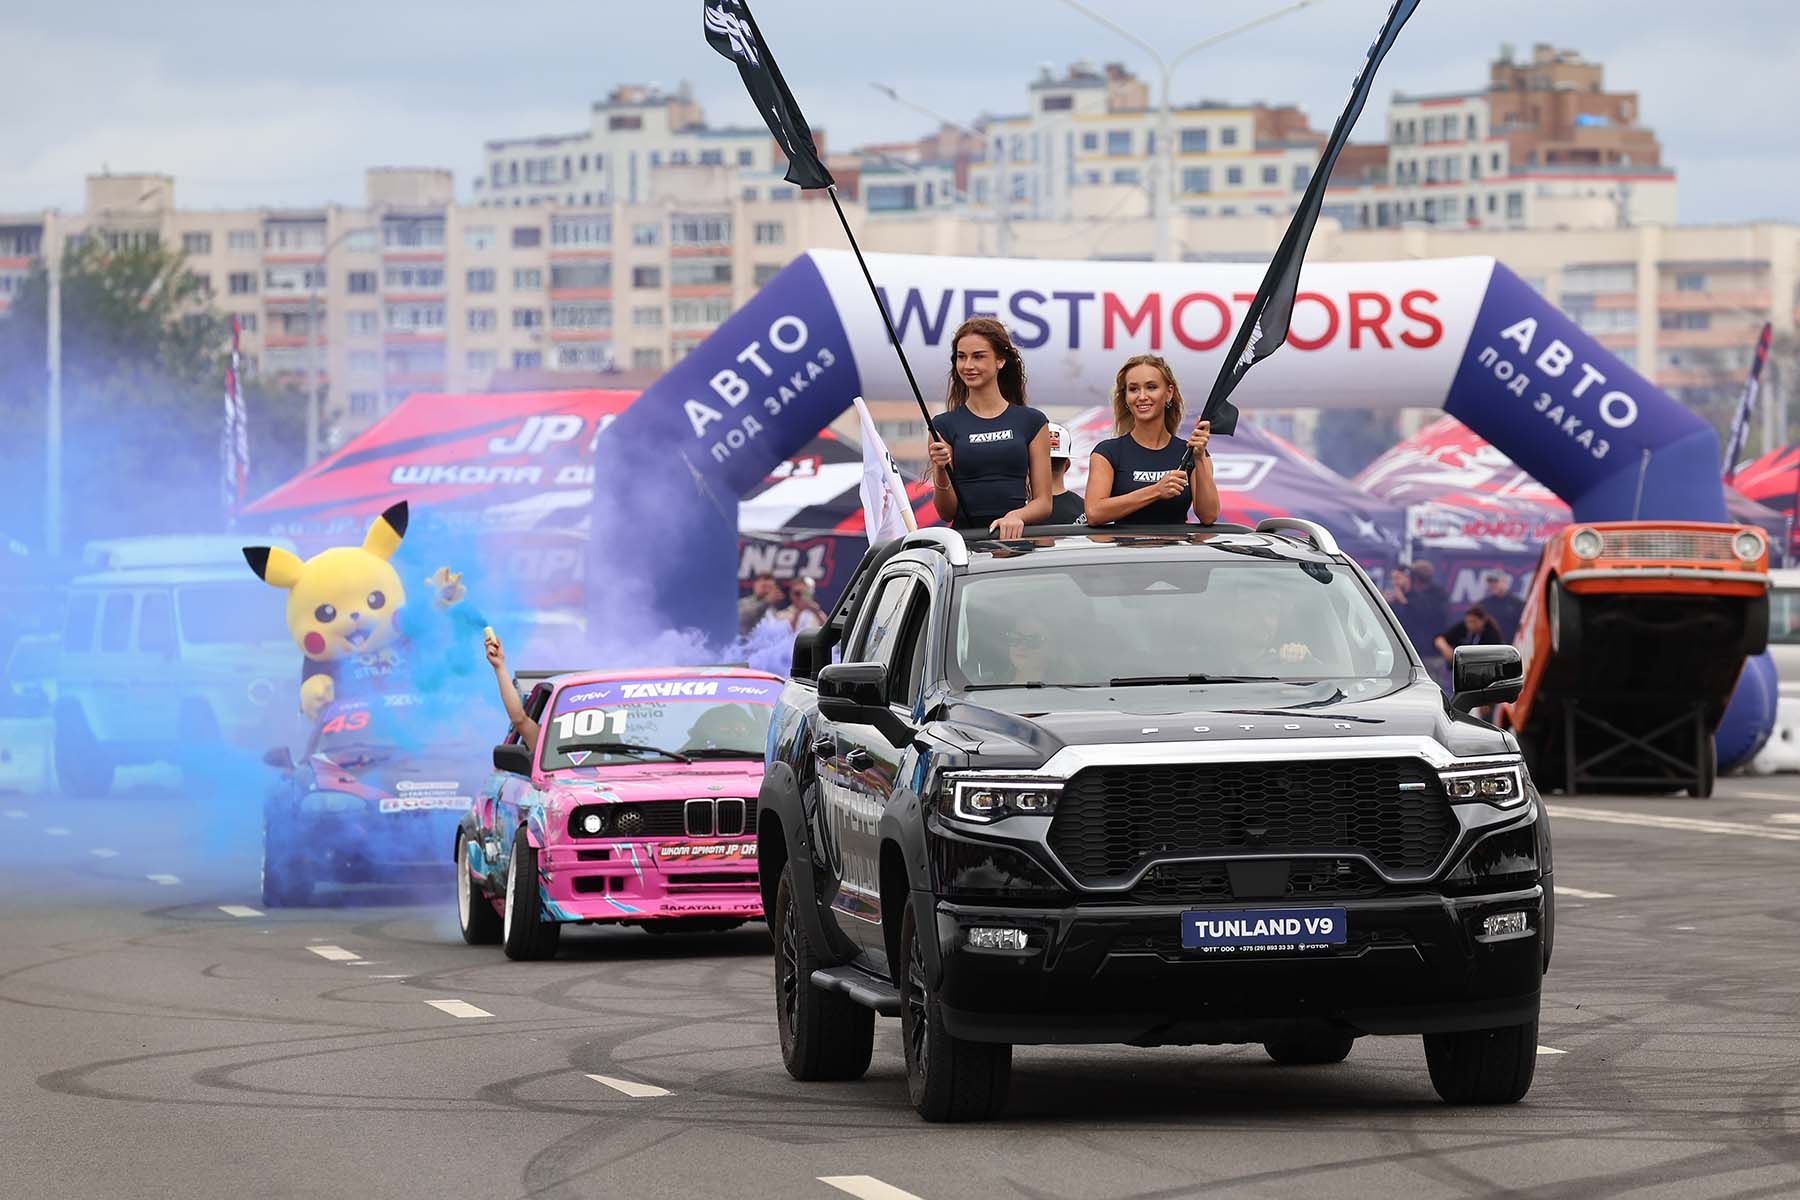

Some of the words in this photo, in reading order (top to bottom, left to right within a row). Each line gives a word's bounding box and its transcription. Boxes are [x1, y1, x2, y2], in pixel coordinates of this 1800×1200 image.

[682, 315, 808, 438] АВТО
[1500, 316, 1638, 429] АВТО
[711, 416, 762, 463] ПОД
[764, 347, 836, 416] ЗАКАЗ
[1477, 345, 1530, 397] ПОД
[1534, 391, 1611, 460] ЗАКАЗ
[488, 415, 584, 455] JP
[969, 429, 1013, 443] ТАЧКИ
[620, 681, 718, 699] ТАЧКИ
[322, 711, 370, 734] 43
[553, 709, 627, 740] 101
[1142, 722, 1351, 735] FOTON
[725, 844, 738, 855] JP
[1195, 918, 1301, 938] TUNLAND
[1304, 917, 1333, 935] V9
